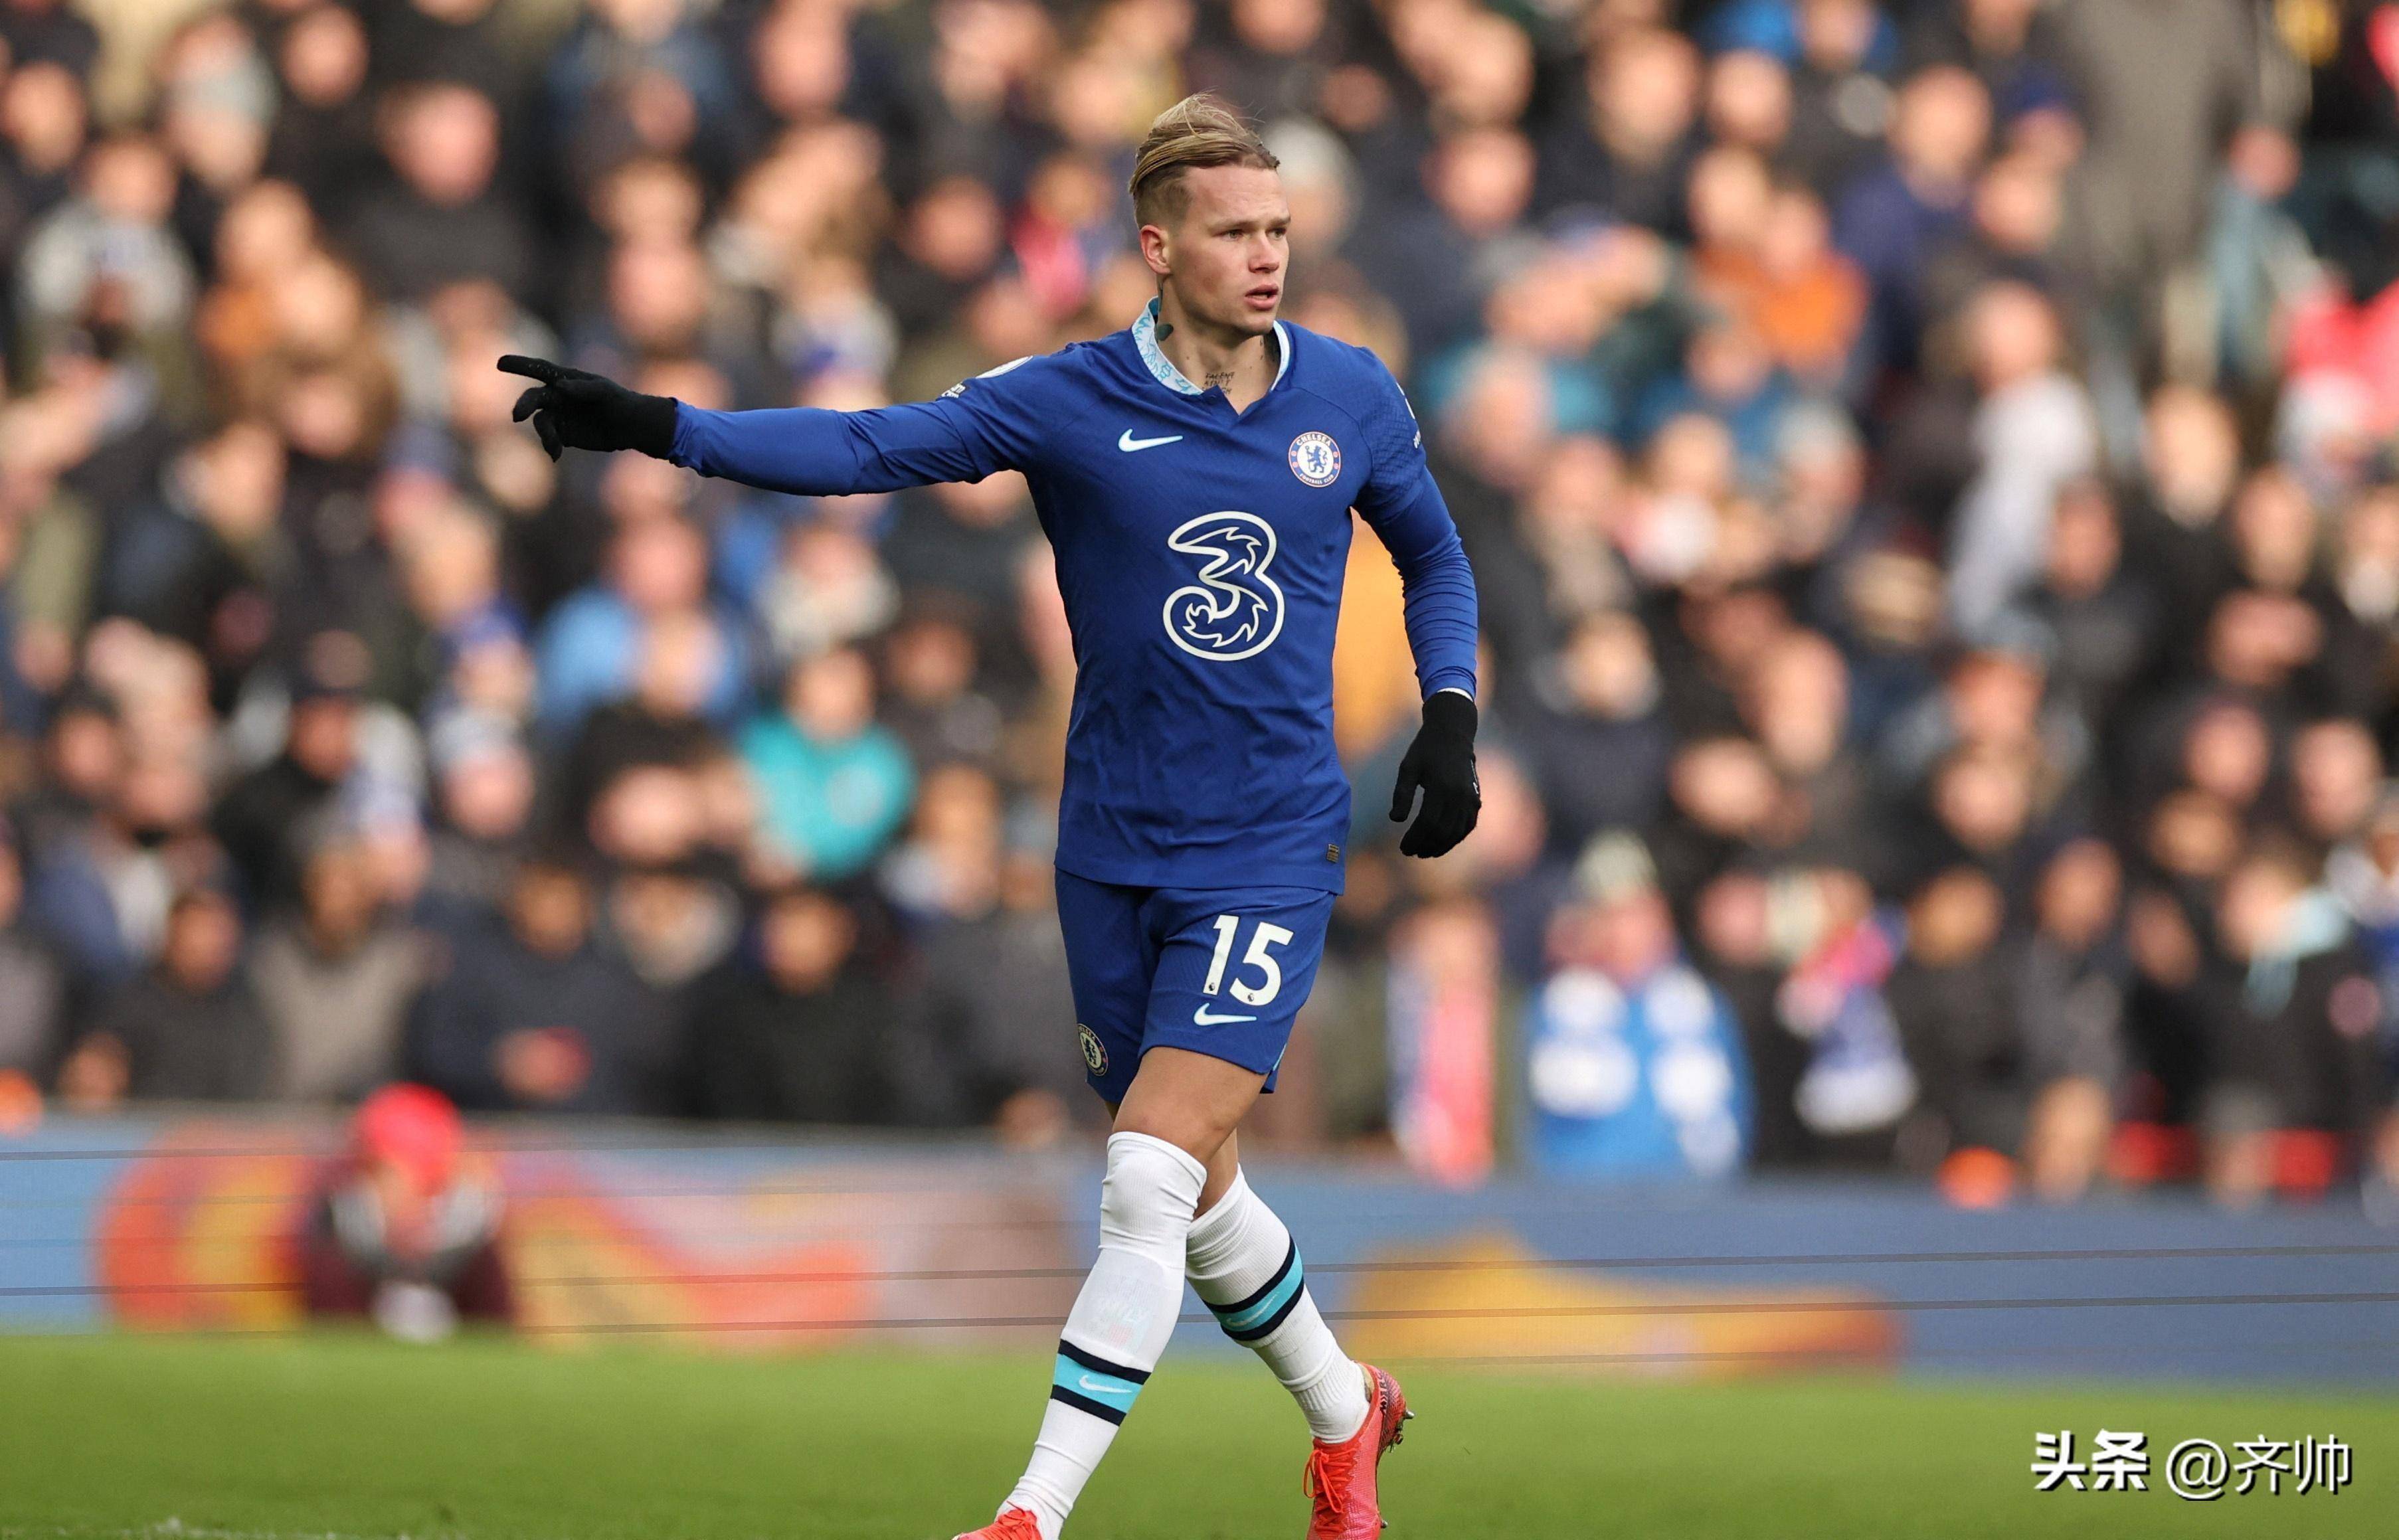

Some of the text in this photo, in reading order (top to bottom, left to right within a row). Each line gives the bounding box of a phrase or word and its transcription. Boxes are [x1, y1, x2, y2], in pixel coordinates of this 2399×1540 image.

[1296, 434, 1331, 447] CHELSEA
[1162, 510, 1285, 661] 3
[1203, 914, 1294, 1006] 15
